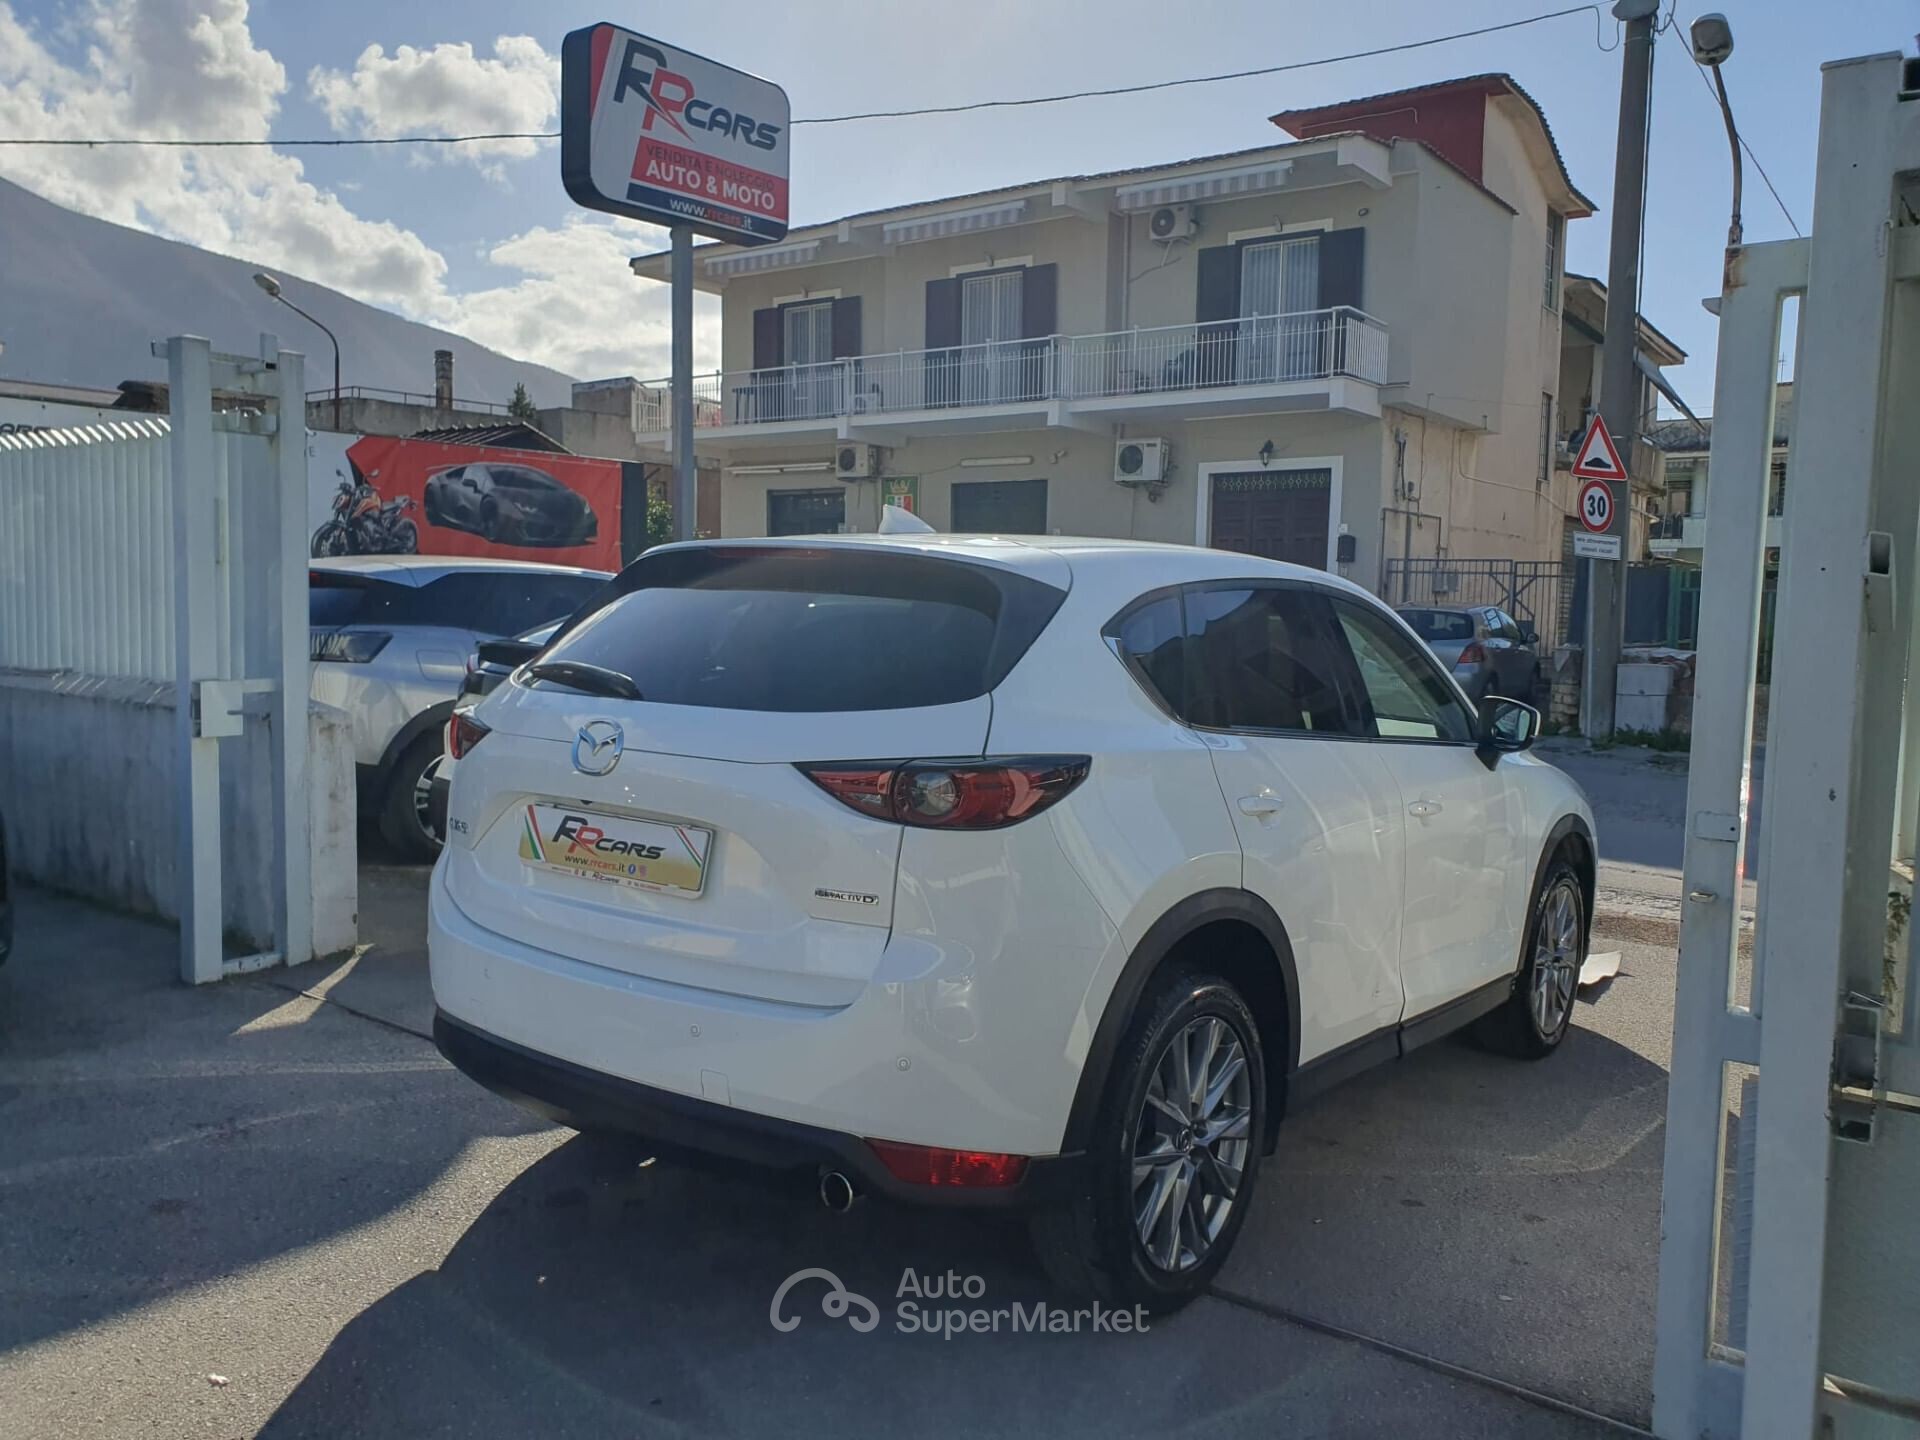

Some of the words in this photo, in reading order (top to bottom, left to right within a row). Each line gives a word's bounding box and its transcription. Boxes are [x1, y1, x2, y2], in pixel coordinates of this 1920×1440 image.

[647, 145, 701, 170] VENDITA
[706, 160, 713, 173] E
[646, 160, 701, 189] AUTO
[706, 175, 718, 195] &
[722, 180, 775, 210] MOTO
[1587, 494, 1607, 518] 30
